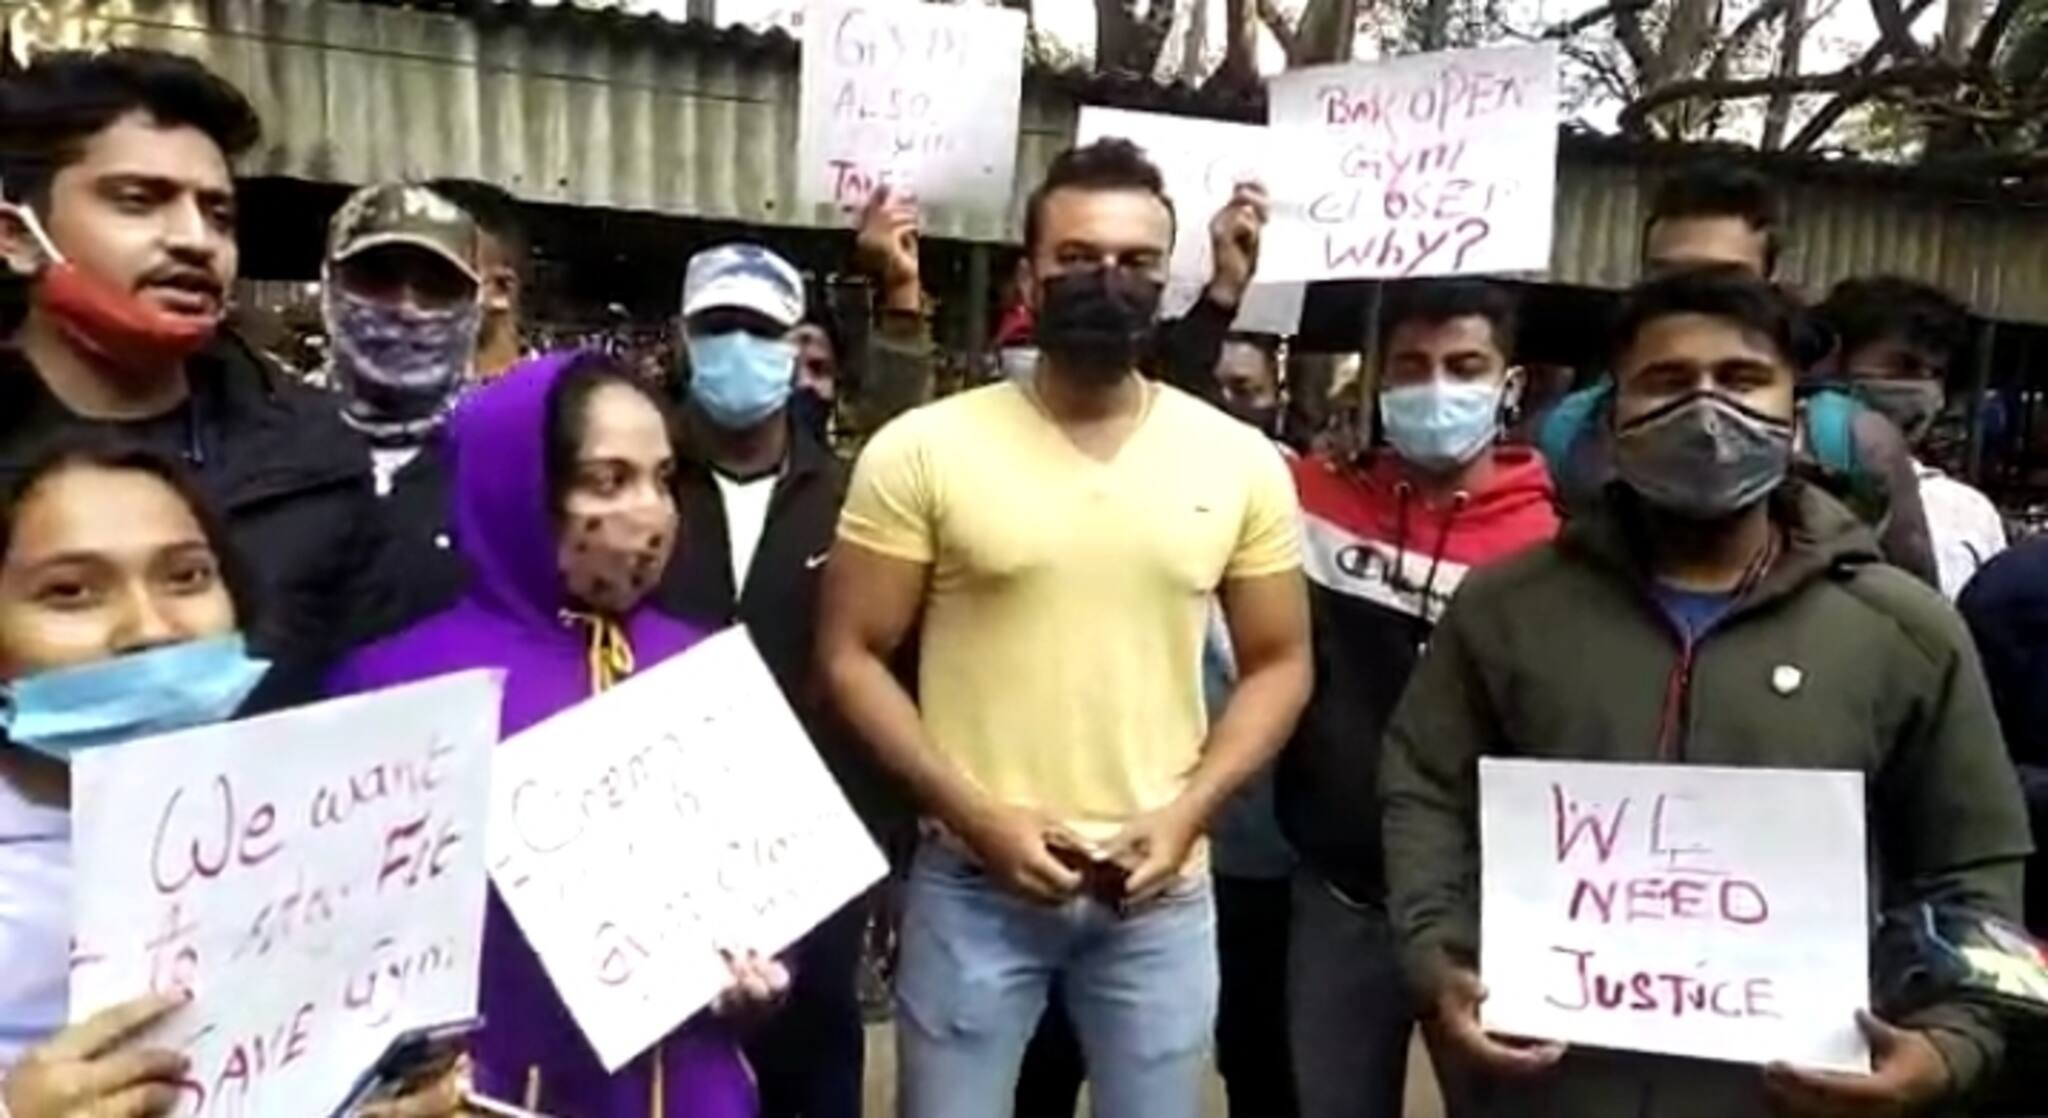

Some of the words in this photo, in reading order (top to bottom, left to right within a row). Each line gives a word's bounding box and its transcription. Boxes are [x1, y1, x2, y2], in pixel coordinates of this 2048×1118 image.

[151, 773, 286, 893] We
[311, 733, 455, 828] want
[1568, 876, 1769, 924] NEED
